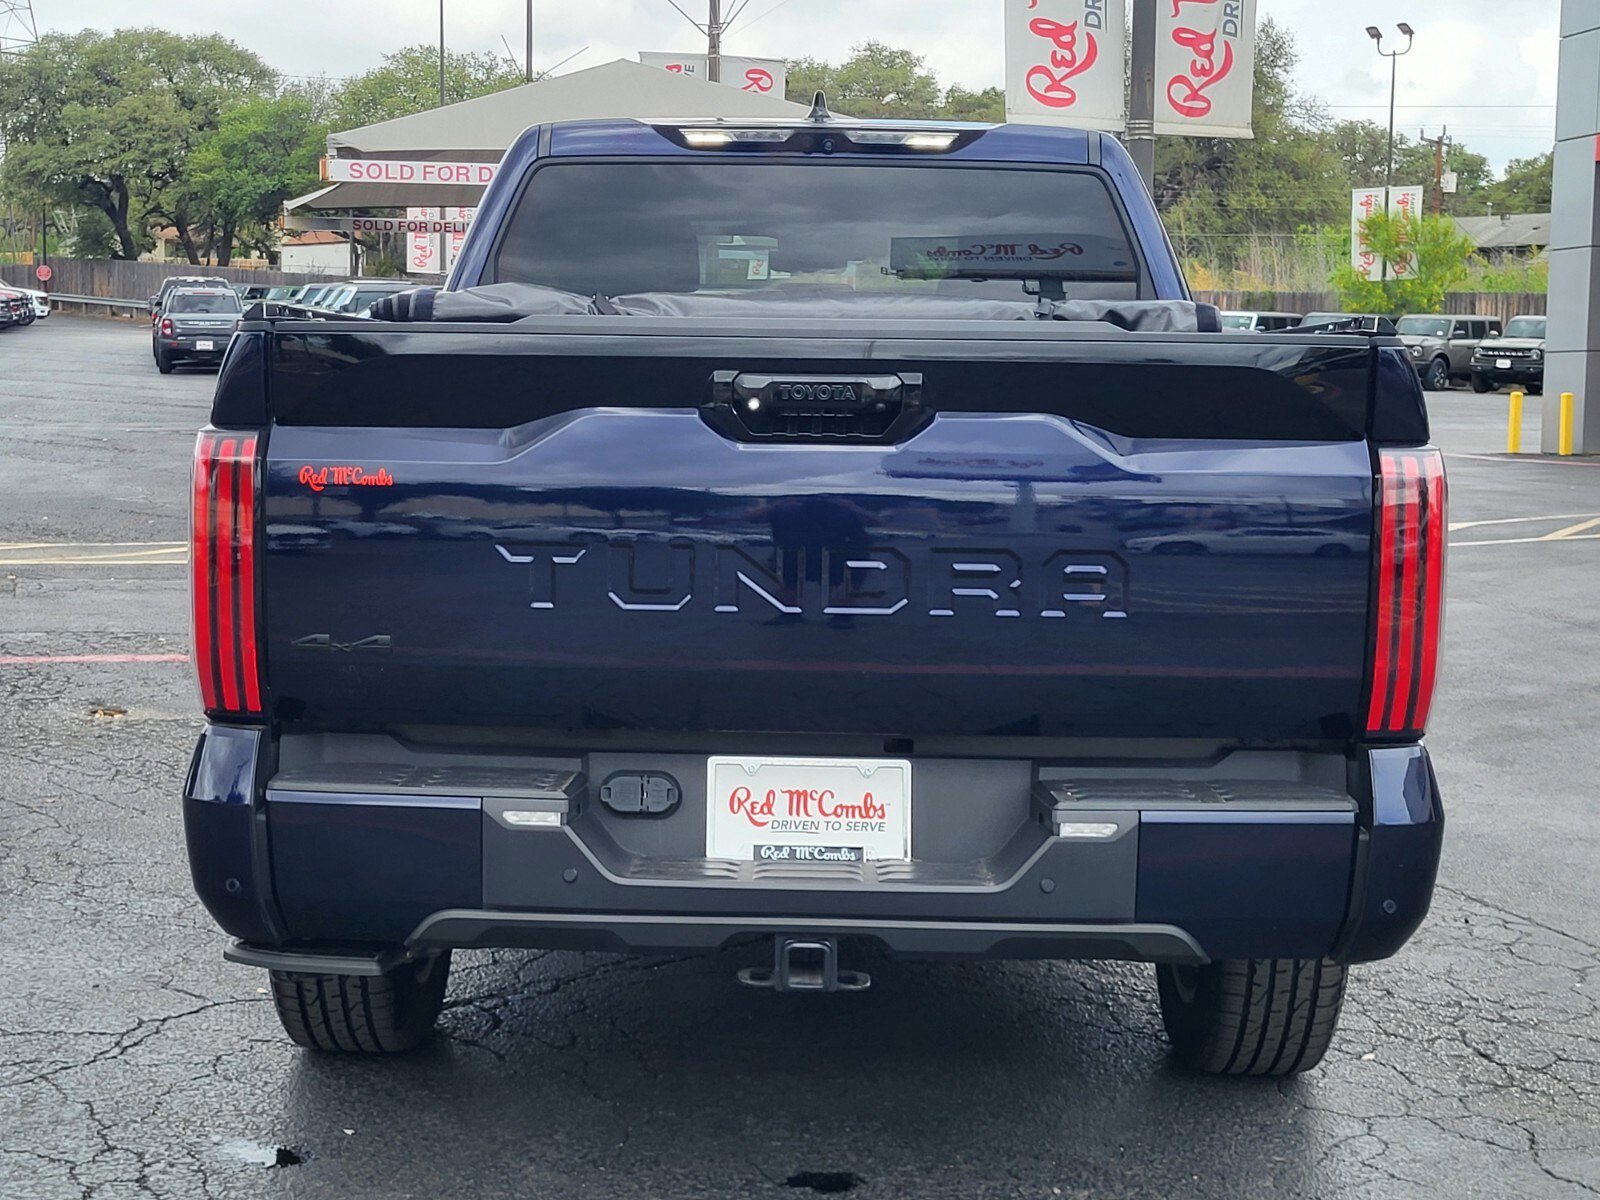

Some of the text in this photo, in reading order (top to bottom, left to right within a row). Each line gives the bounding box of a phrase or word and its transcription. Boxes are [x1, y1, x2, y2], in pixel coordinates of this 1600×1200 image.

[1026, 18, 1098, 108] Red
[1166, 27, 1234, 118] Red
[350, 162, 495, 183] SOLD FOR D
[352, 220, 393, 232] SOLD
[398, 221, 428, 232] FOR
[779, 384, 857, 400] TOYOTA
[299, 465, 393, 491] Red McCombs
[495, 541, 1130, 618] TUNDRA
[729, 786, 886, 827] Red McCombs
[770, 819, 886, 833] DRIVEN TO SERVE
[760, 845, 857, 862] Red McCombs
